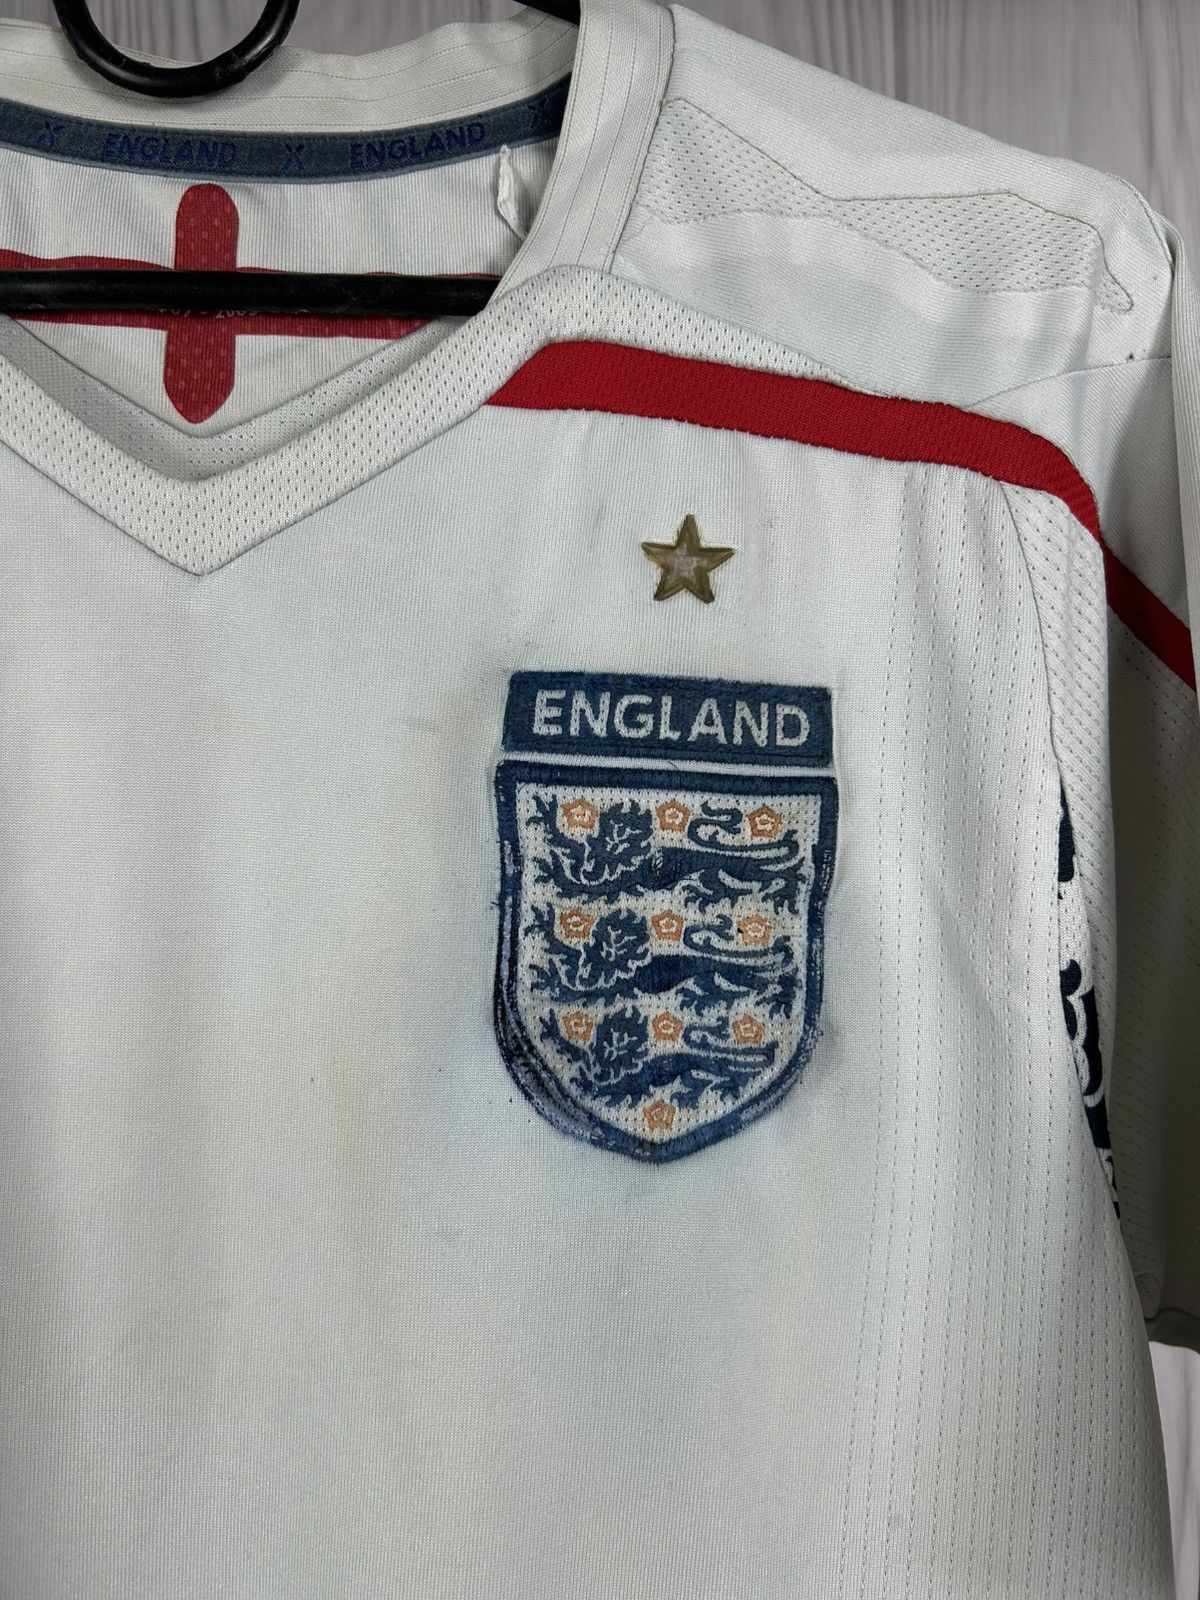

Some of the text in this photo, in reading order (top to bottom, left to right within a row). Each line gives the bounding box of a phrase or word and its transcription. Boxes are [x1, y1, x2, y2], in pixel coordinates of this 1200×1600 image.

[101, 131, 237, 168] ENGLAND
[349, 121, 486, 171] ENGLAND
[532, 689, 811, 747] ENGLAND
